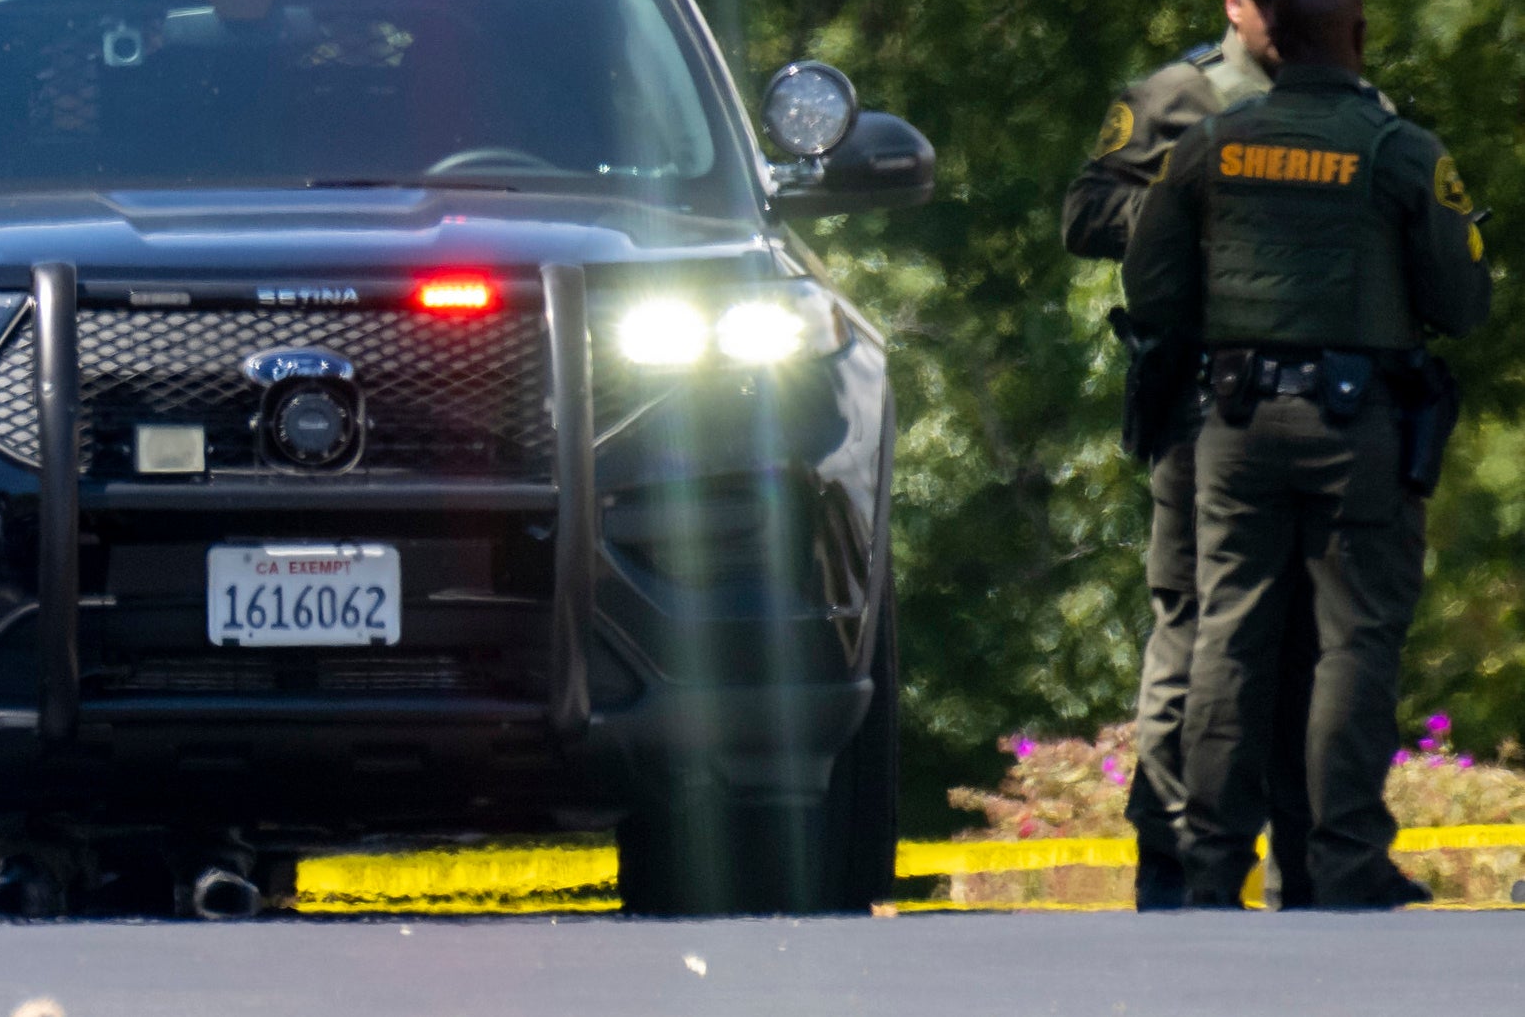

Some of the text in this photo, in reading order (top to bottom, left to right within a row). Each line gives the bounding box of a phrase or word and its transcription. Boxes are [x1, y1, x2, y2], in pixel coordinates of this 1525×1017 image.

[1220, 143, 1360, 184] SHERIFF
[255, 560, 351, 575] CA EXEMPT
[223, 585, 386, 630] 1616062
